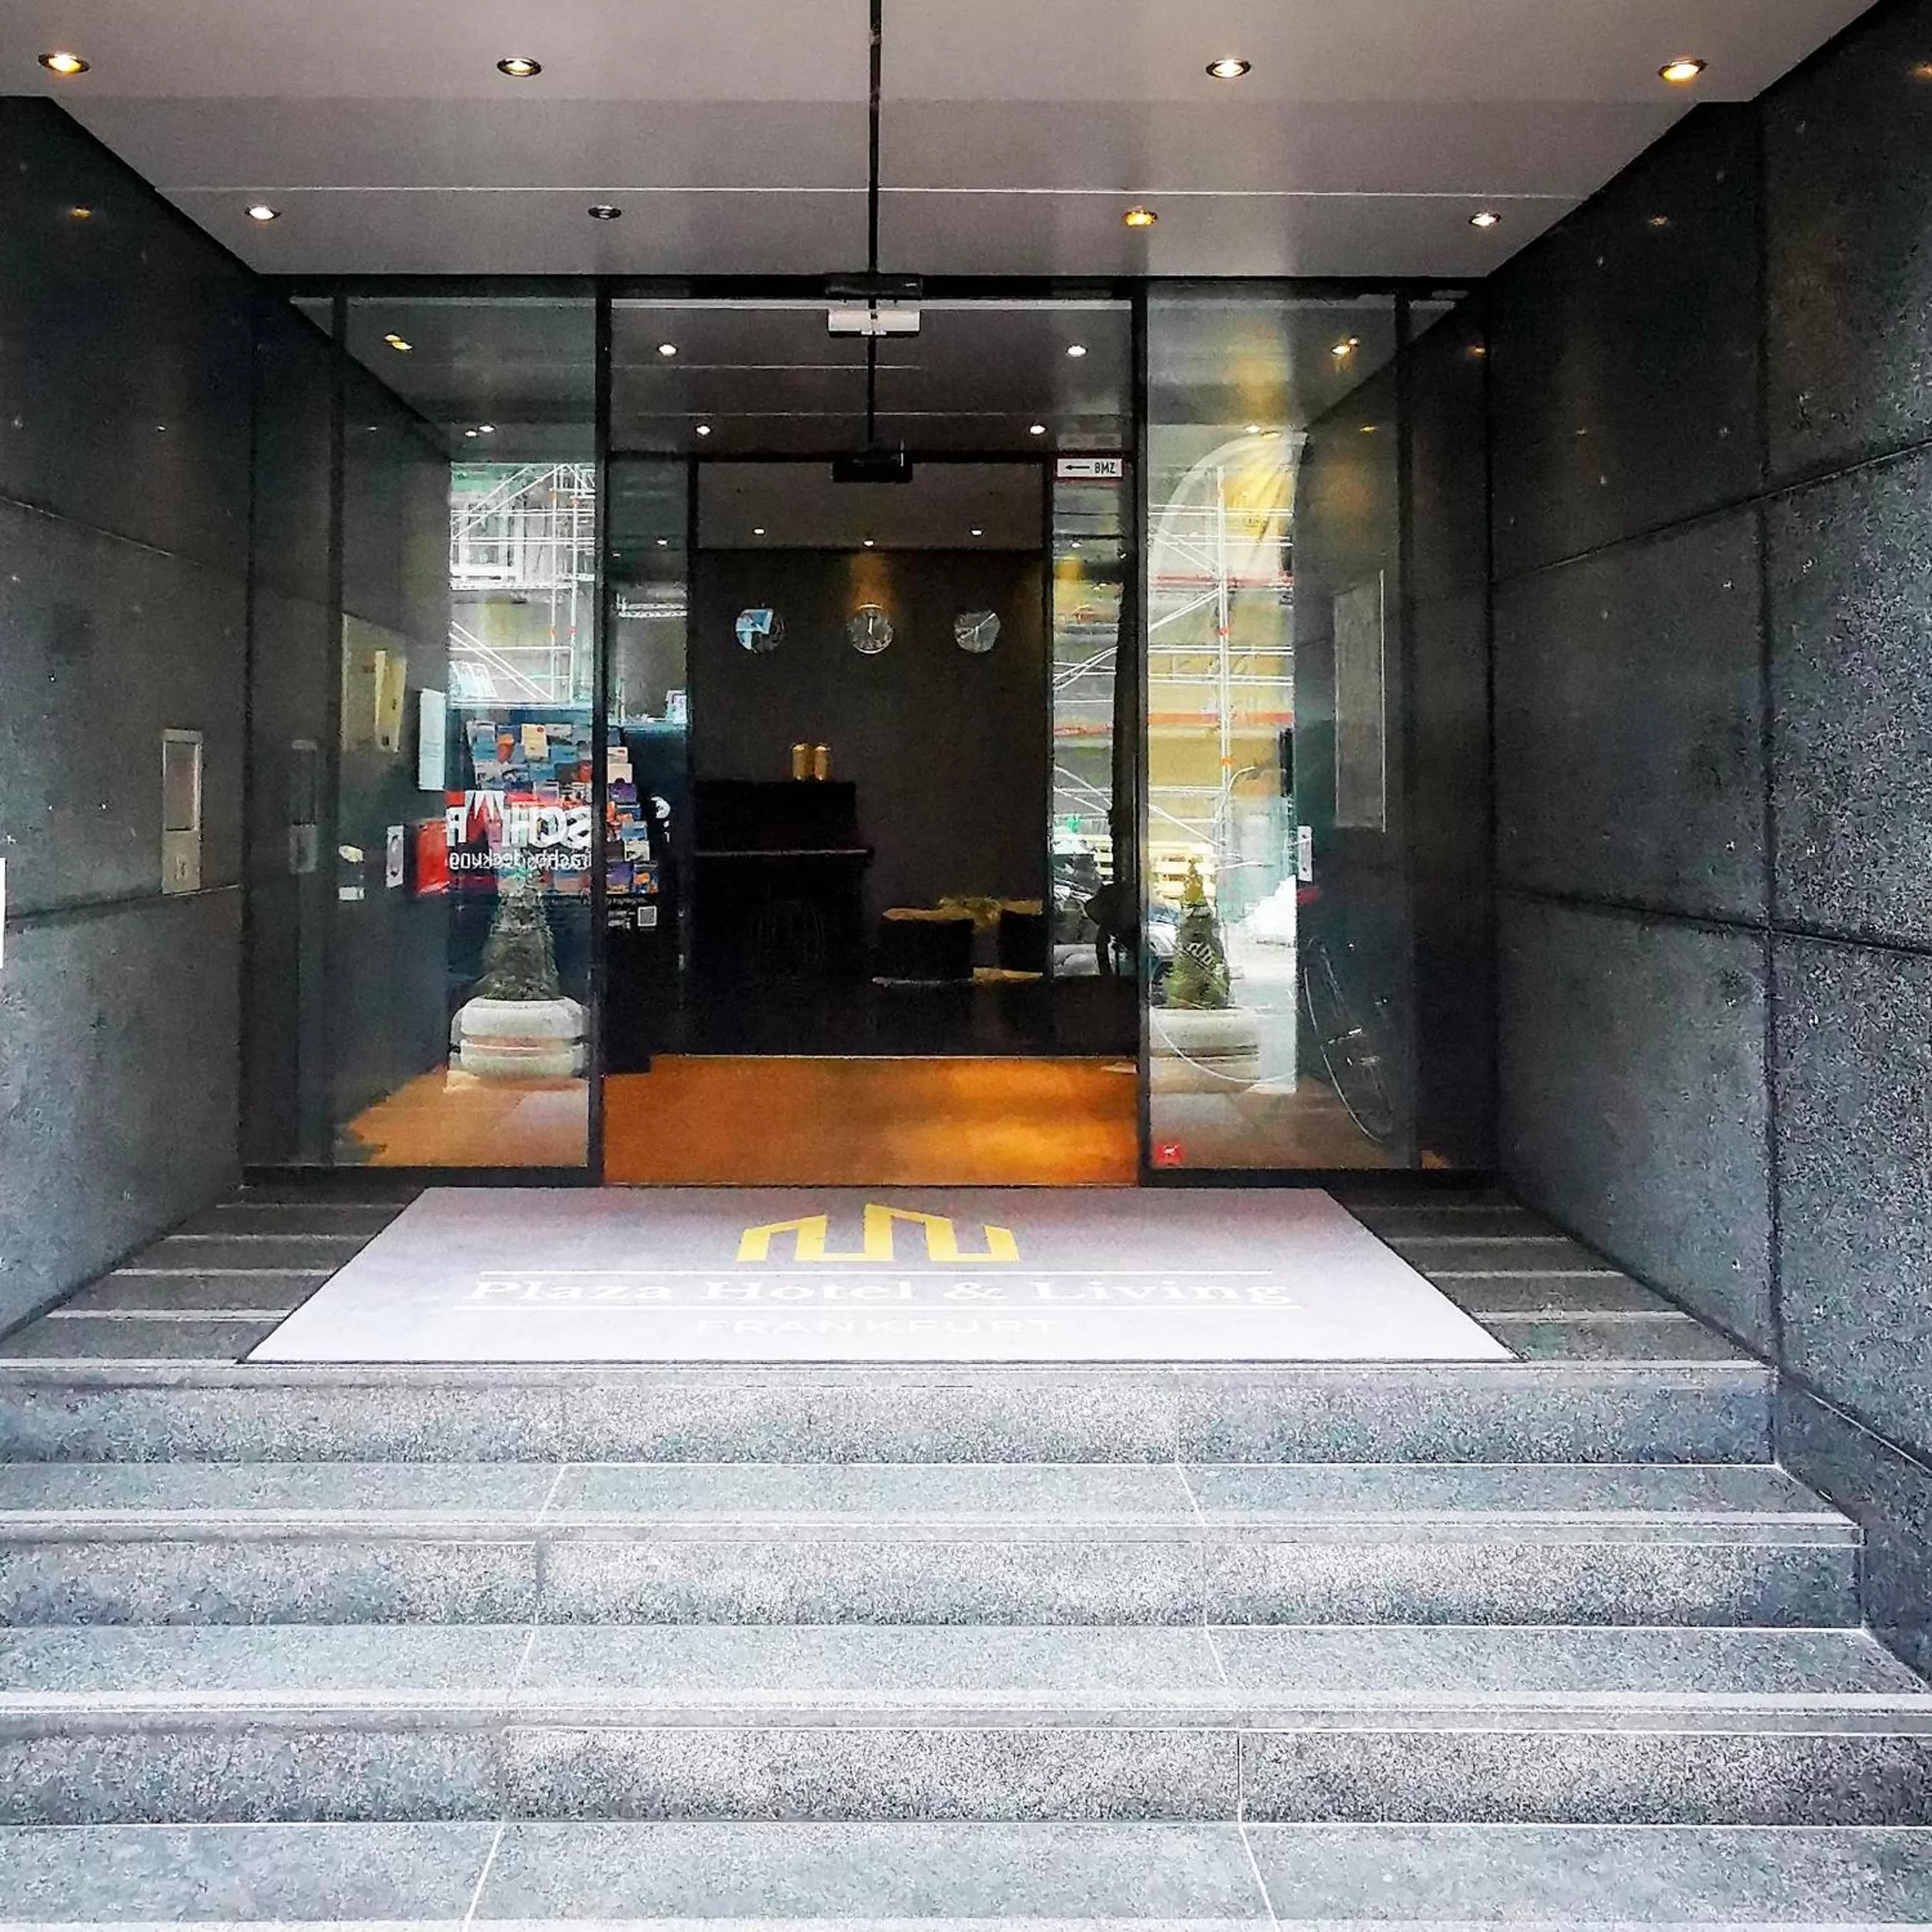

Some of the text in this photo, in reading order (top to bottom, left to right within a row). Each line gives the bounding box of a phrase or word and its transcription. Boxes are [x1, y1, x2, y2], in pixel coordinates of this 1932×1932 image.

[1094, 461, 1117, 474] BMZ
[461, 1280, 1293, 1305] Plaza Hotel & Living
[697, 1319, 1061, 1333] FRANKFURT
